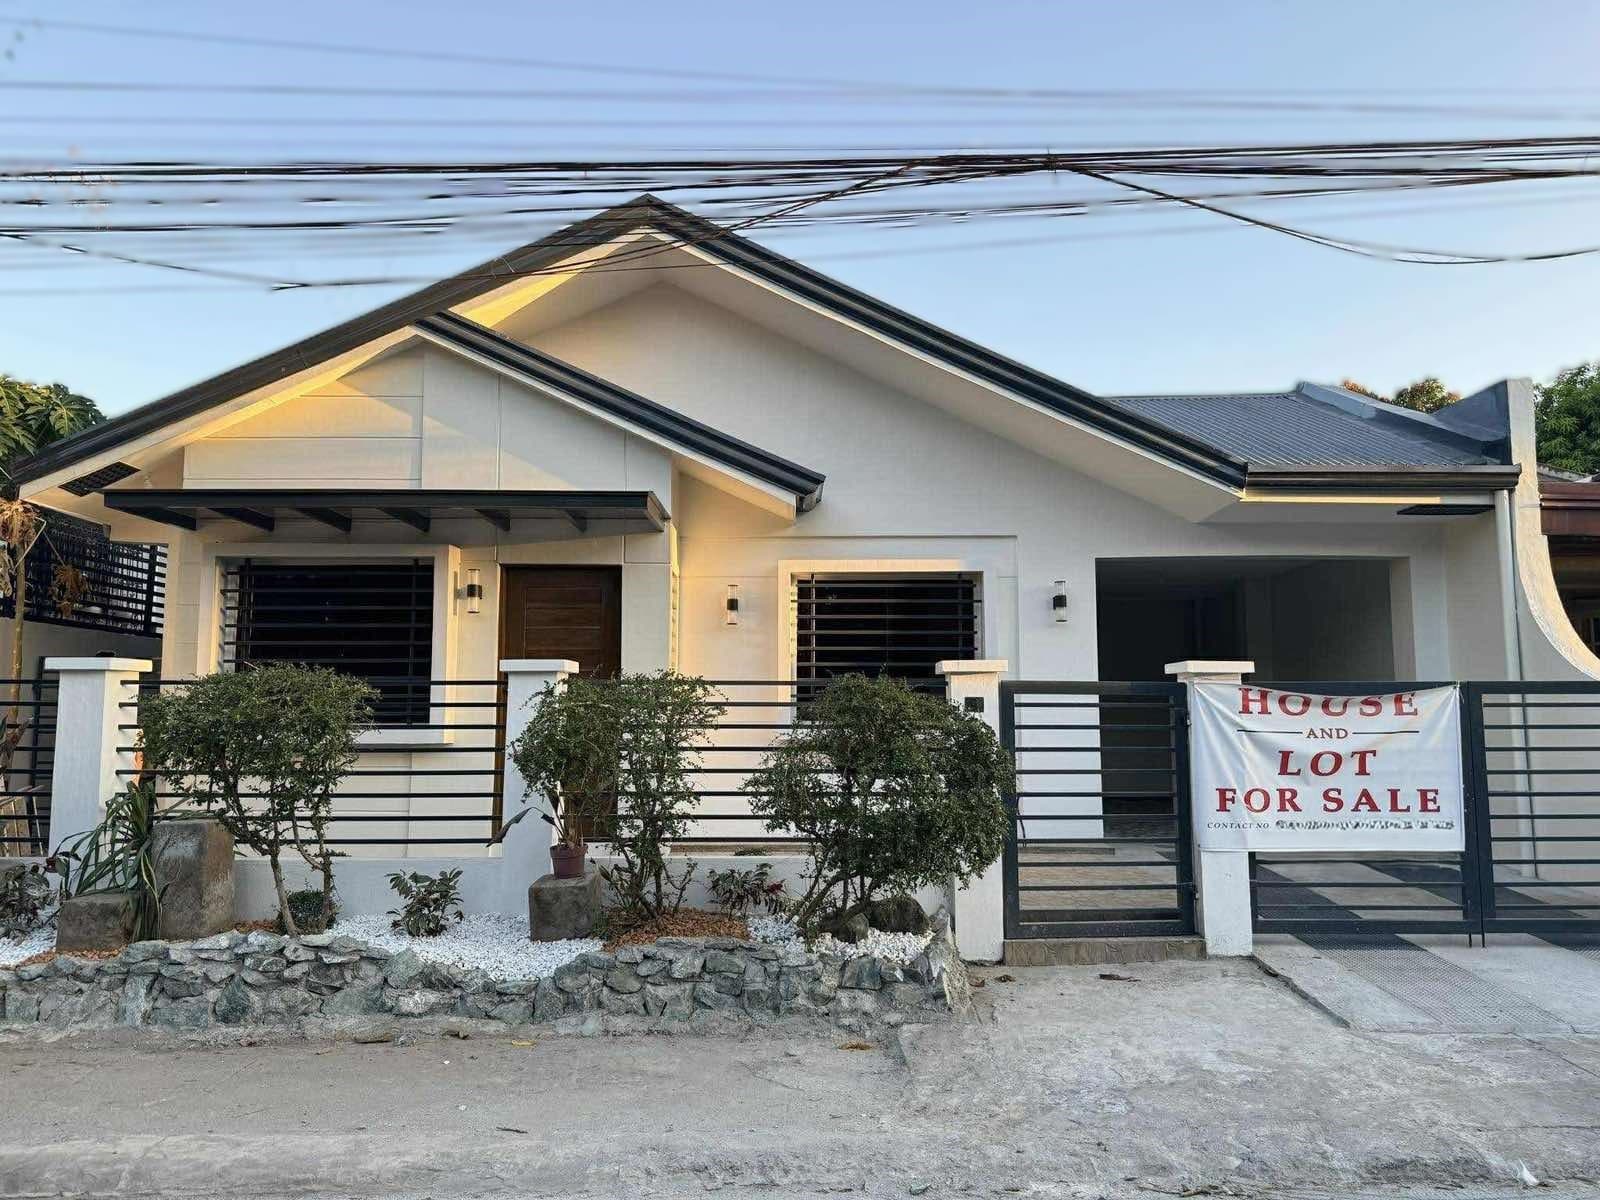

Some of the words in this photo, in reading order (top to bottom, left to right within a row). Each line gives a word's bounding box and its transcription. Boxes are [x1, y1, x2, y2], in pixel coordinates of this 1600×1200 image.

[1238, 688, 1418, 717] HOUSE
[1306, 728, 1348, 739] AND
[1278, 750, 1377, 776] LOT
[1216, 788, 1302, 813] FOR
[1323, 788, 1441, 813] SALE
[1207, 822, 1253, 830] CONTACT
